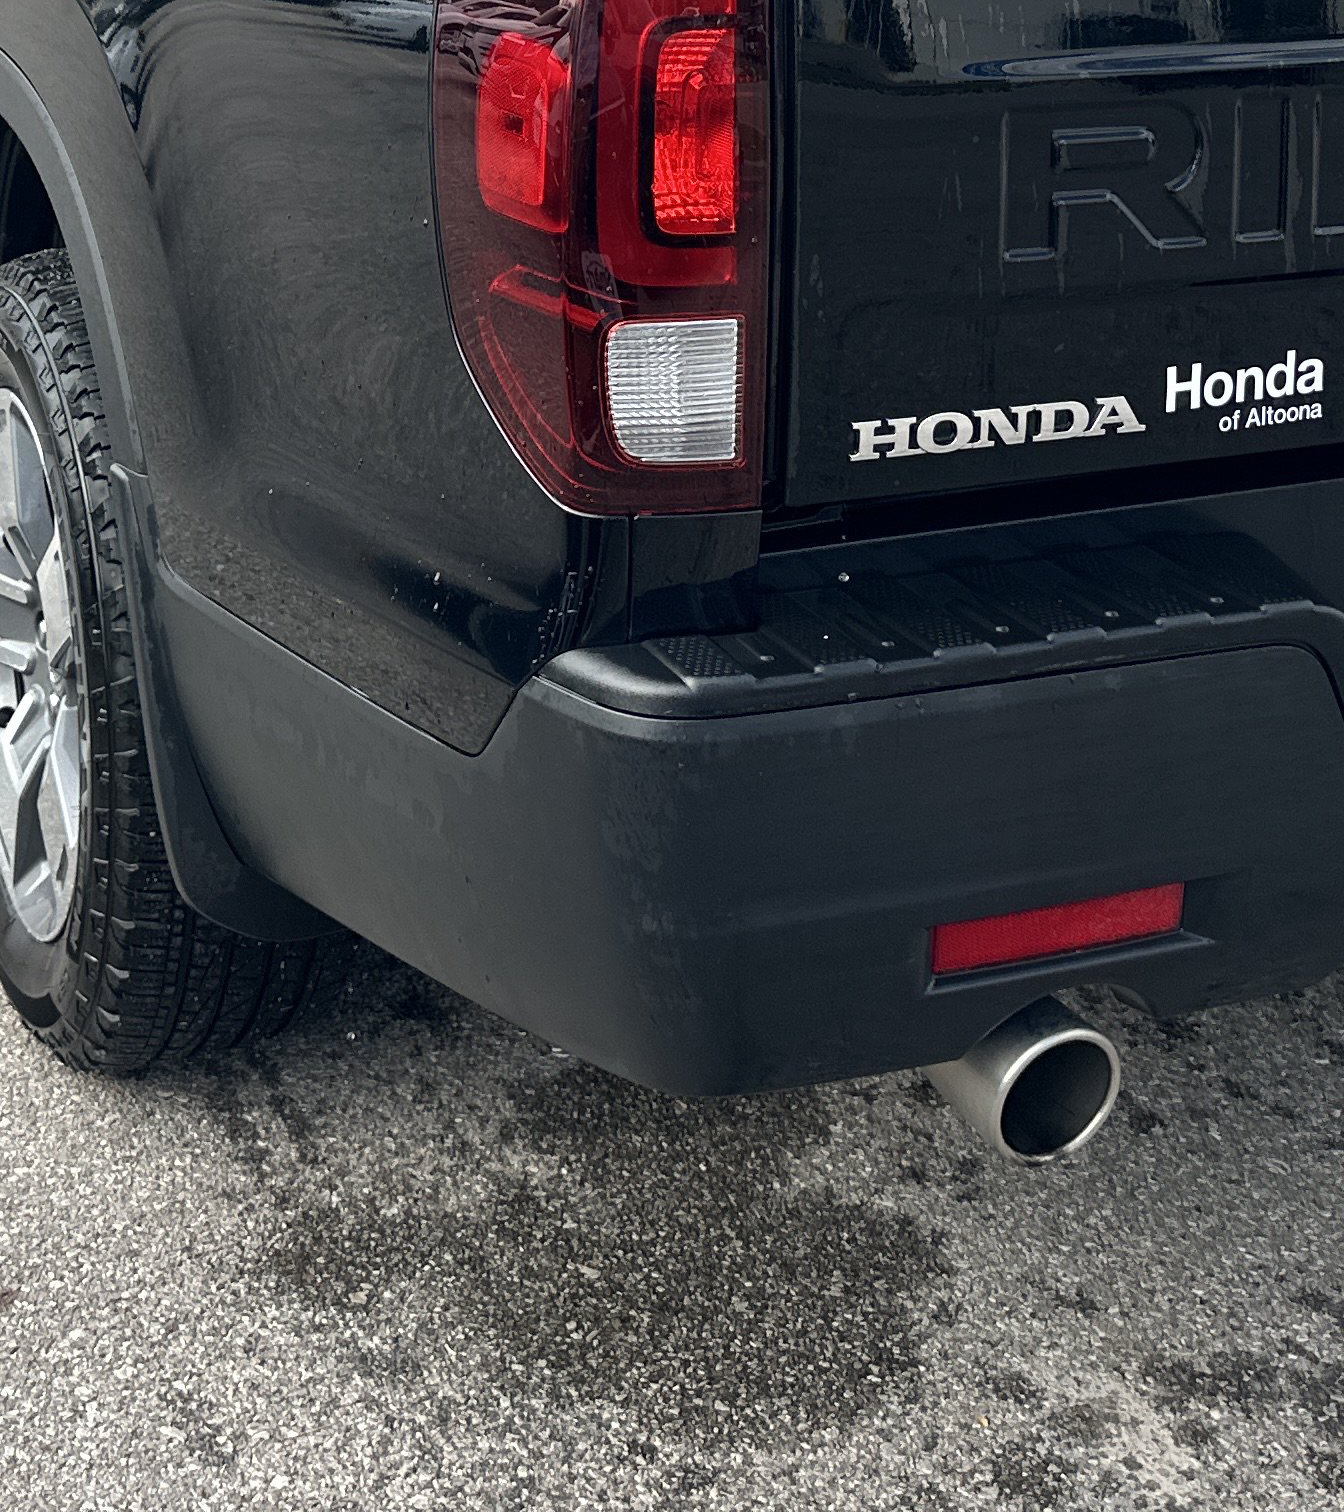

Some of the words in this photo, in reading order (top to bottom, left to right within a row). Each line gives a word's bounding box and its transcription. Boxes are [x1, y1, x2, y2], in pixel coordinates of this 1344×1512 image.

[1164, 349, 1325, 413] Honda
[848, 394, 1147, 462] HONDA
[1218, 412, 1242, 433] of
[1244, 399, 1323, 429] Altoona
